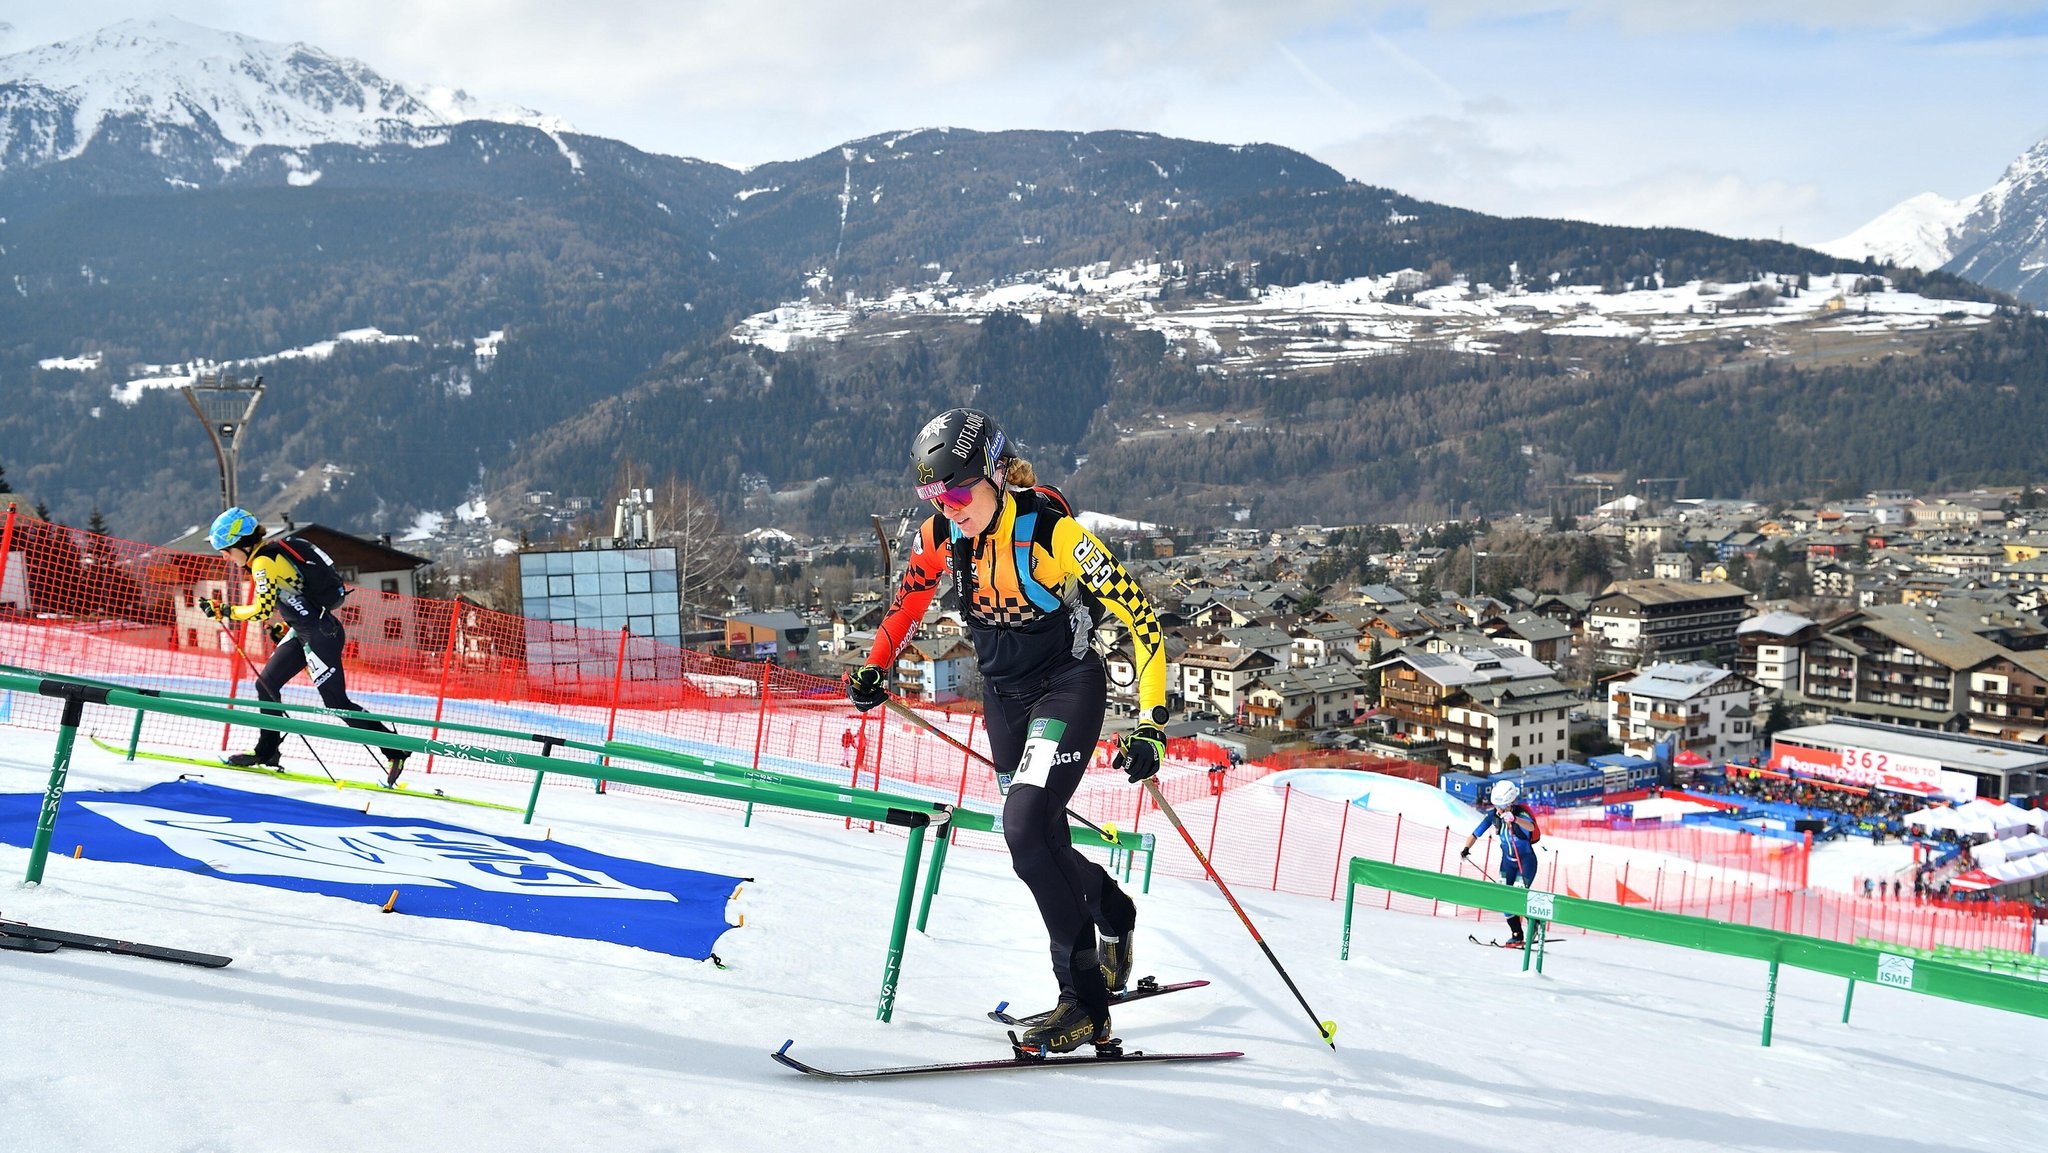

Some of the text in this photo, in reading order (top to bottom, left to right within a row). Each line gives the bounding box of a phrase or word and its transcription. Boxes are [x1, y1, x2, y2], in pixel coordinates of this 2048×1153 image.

[951, 412, 985, 459] BIOTEAQUE
[1074, 535, 1112, 588] GER
[256, 569, 268, 593] GER
[1020, 745, 1035, 772] 5
[1847, 749, 1936, 777] 362 DAYS TO
[46, 759, 67, 826] LISKI
[1528, 905, 1551, 917] ISMF
[879, 956, 895, 1020] LISKI
[1880, 972, 1910, 985] ISMF
